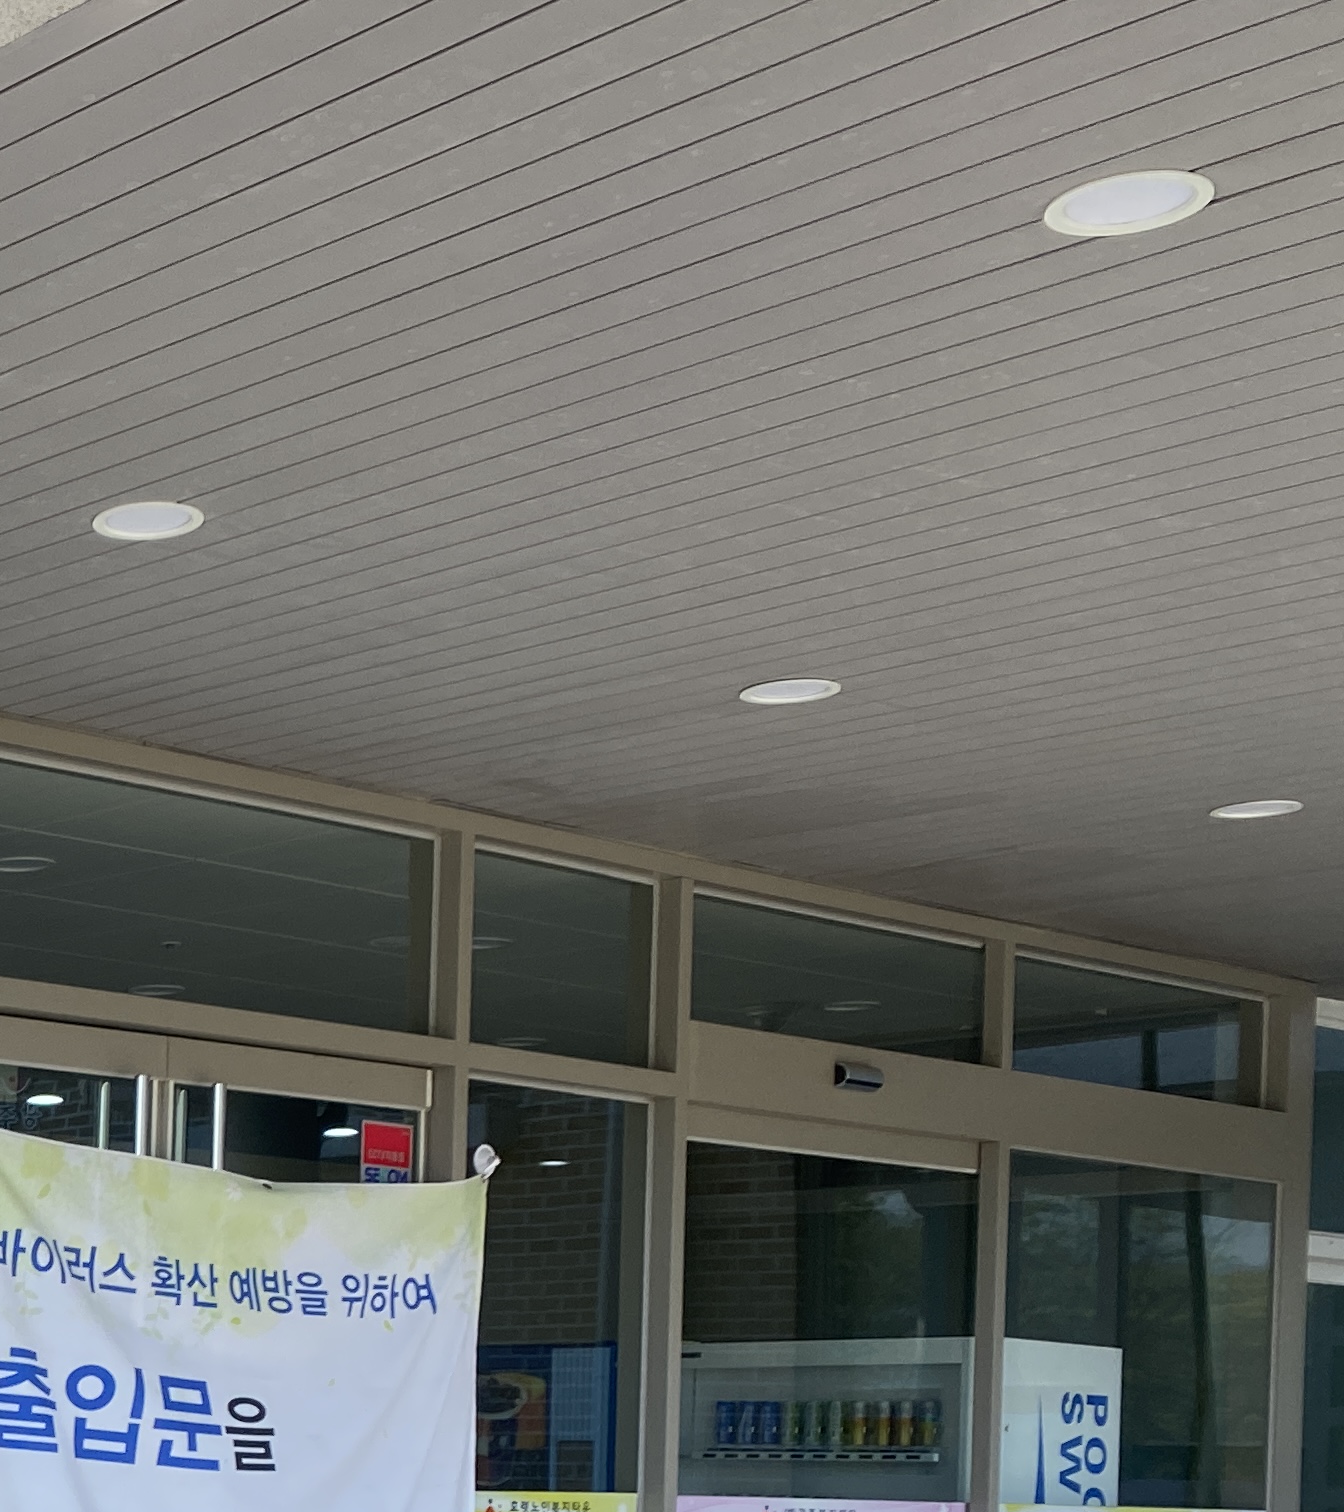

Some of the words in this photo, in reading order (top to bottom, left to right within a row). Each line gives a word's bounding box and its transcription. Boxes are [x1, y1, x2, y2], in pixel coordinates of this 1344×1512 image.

[151, 1256, 220, 1309] 확산
[229, 1264, 329, 1318] 예방을
[341, 1269, 438, 1320] 위하여
